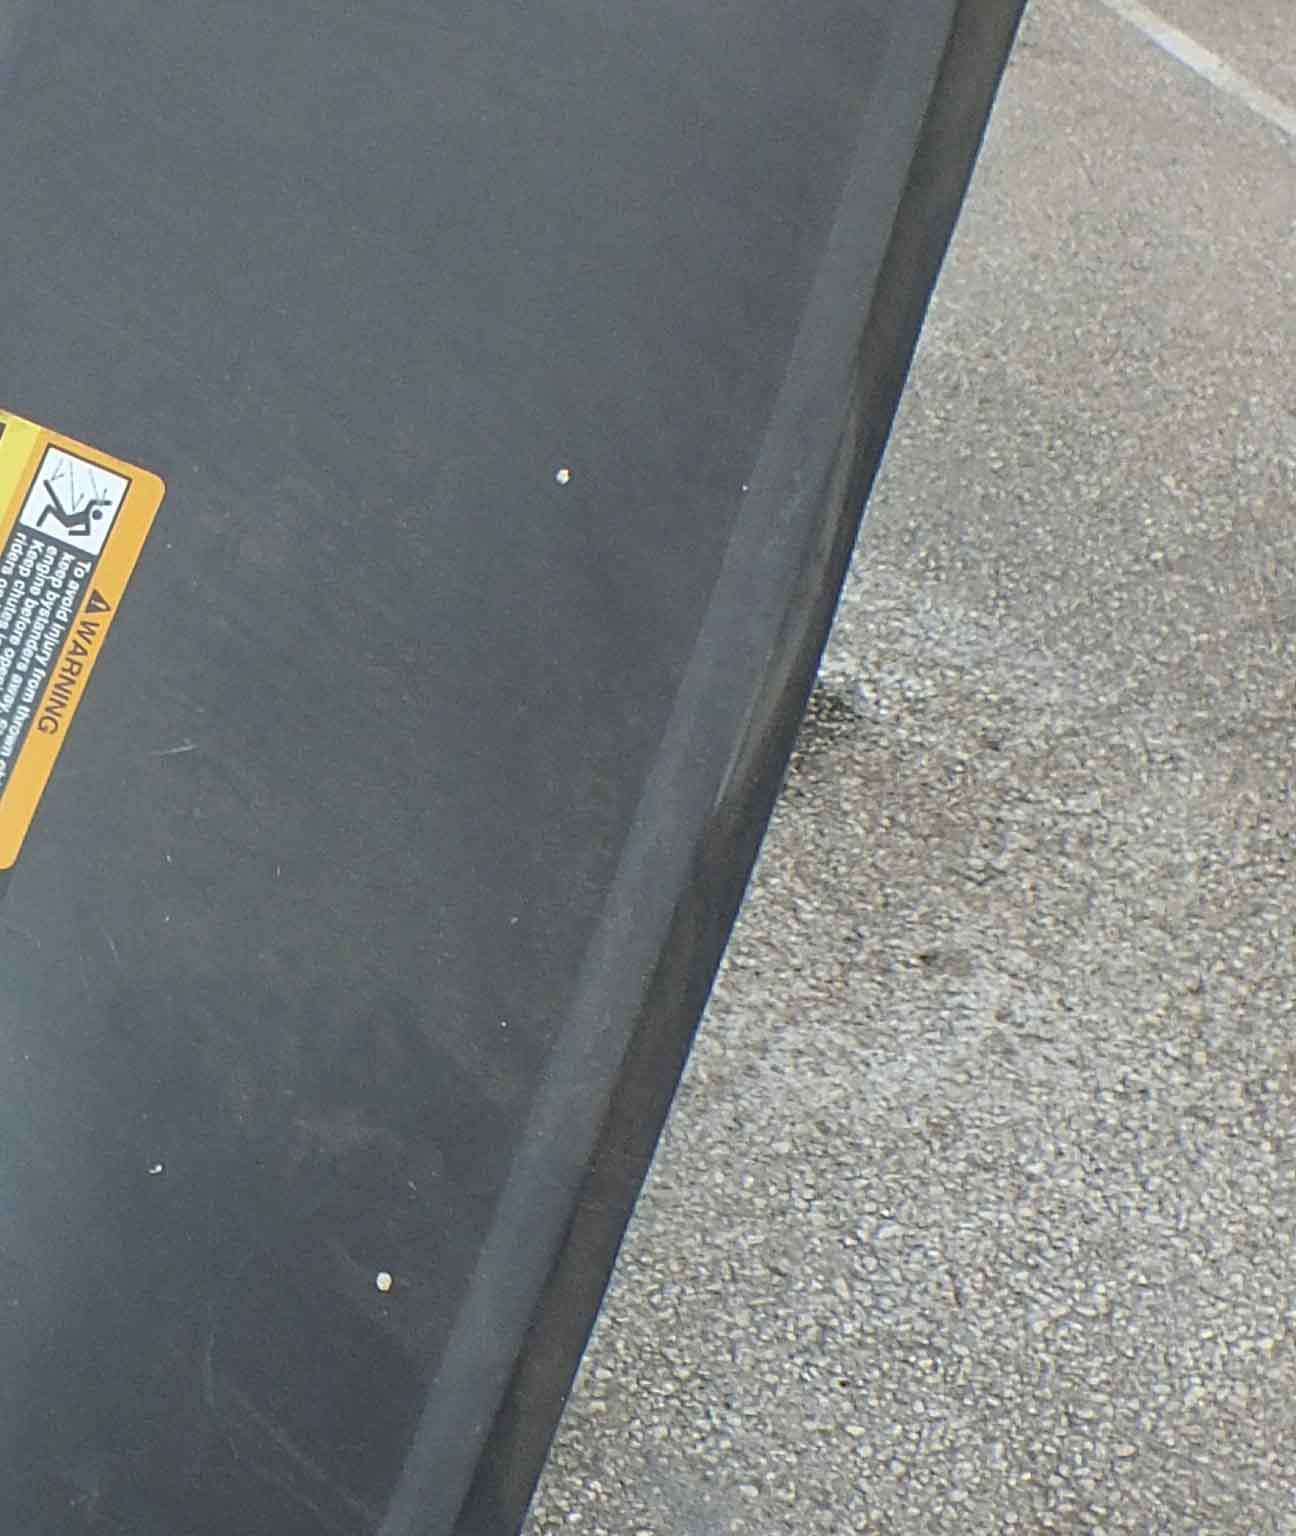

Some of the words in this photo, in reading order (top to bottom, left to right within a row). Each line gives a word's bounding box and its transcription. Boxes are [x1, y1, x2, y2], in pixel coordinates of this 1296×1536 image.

[0, 532, 27, 574] riders
[18, 539, 45, 577] Keep
[29, 545, 57, 595] engine
[48, 551, 76, 588] keep
[73, 561, 91, 578] To
[8, 597, 39, 645] before
[55, 579, 79, 622] avoid
[15, 589, 60, 672] bystanders
[34, 622, 65, 665] injury
[21, 667, 46, 702] from
[36, 620, 100, 734] WARNING
[0, 704, 30, 756] thrown
